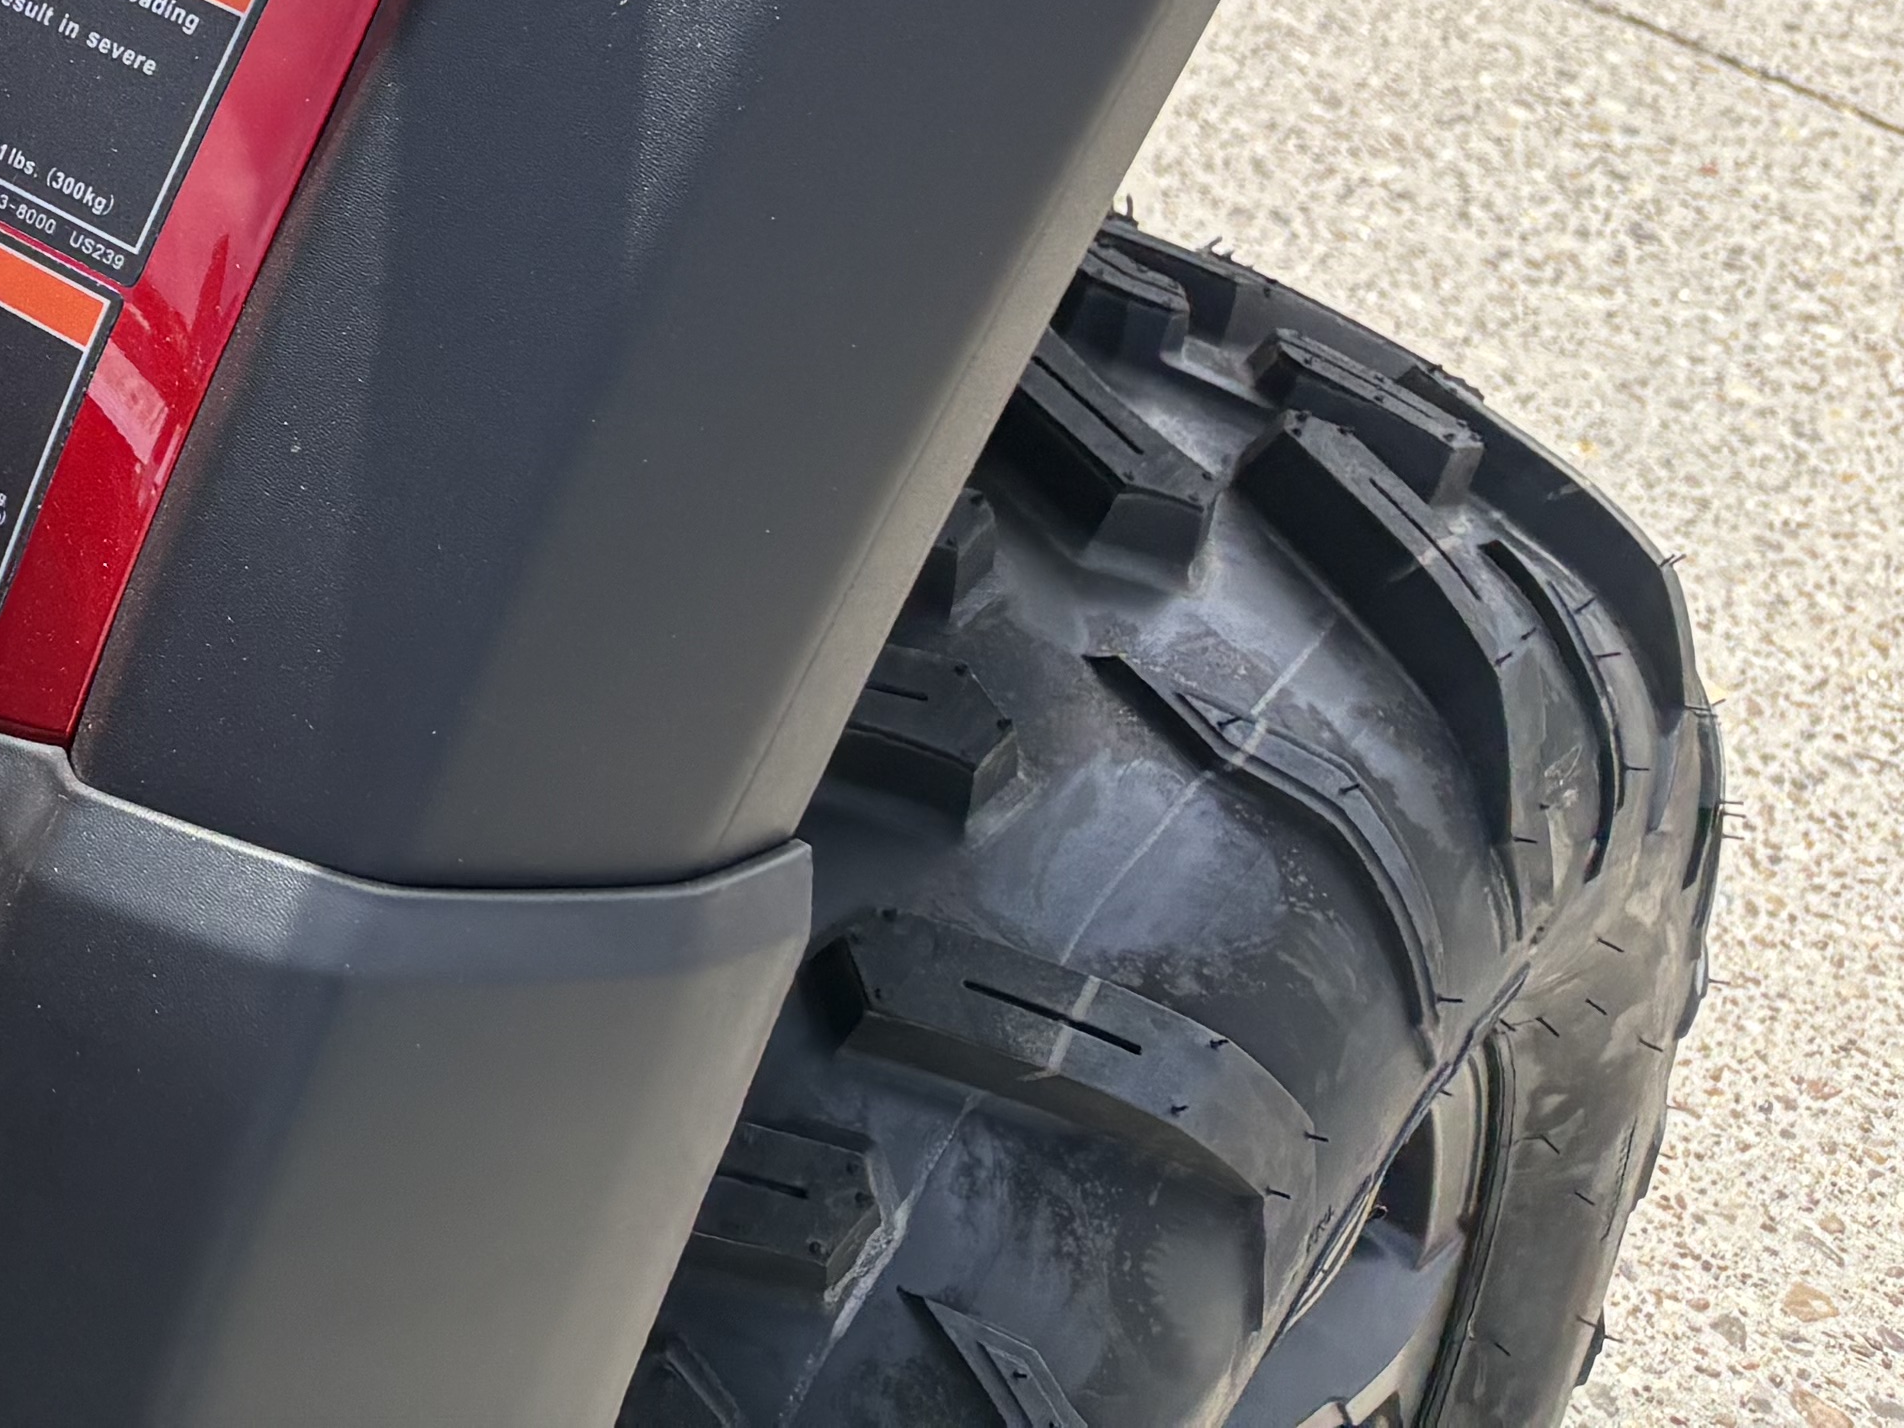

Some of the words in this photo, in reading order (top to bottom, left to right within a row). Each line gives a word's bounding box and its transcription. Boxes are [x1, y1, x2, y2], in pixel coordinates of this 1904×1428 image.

[58, 13, 79, 39] in
[86, 31, 156, 75] severe
[69, 230, 125, 270] US239
